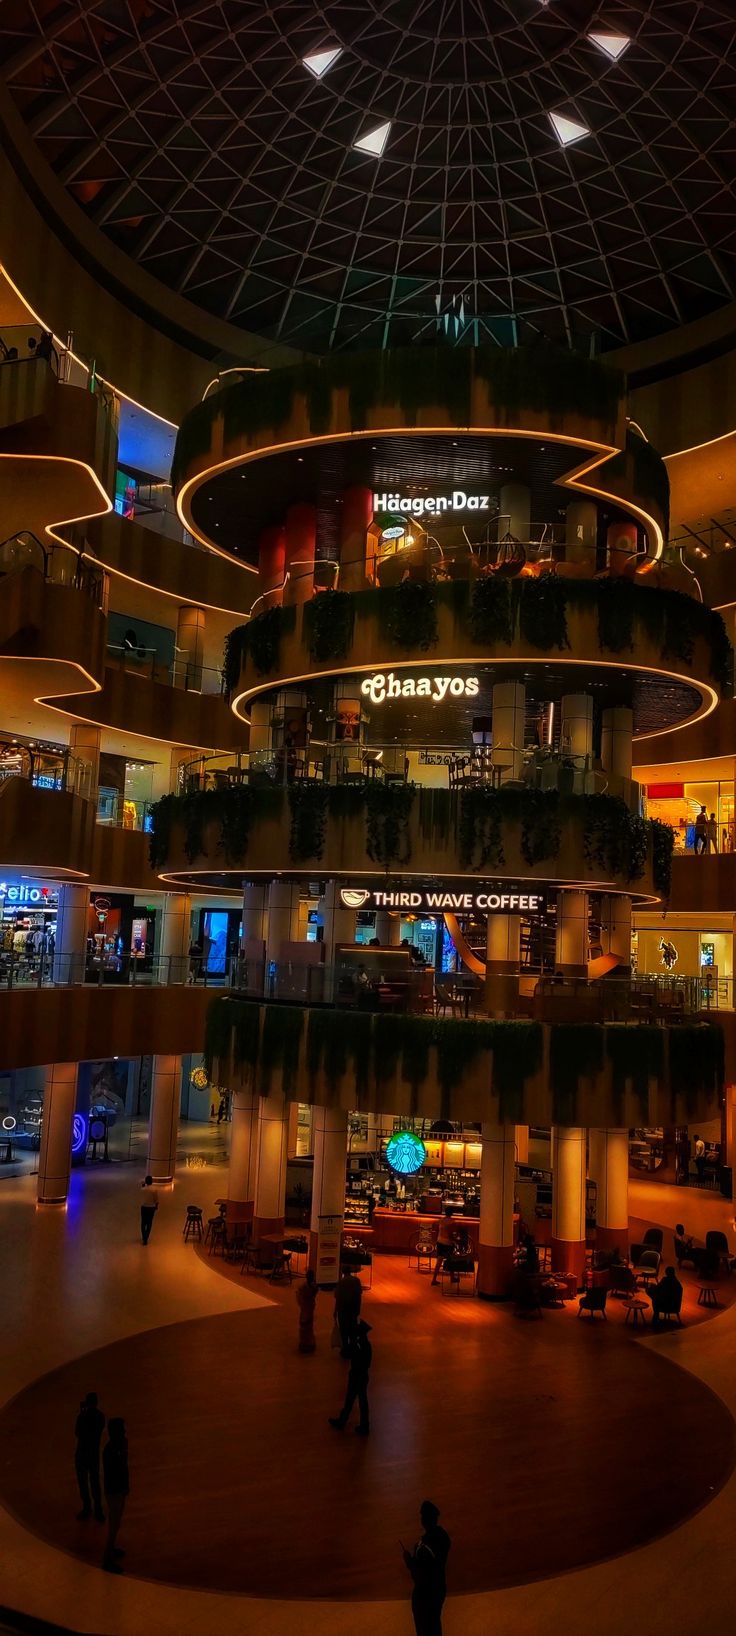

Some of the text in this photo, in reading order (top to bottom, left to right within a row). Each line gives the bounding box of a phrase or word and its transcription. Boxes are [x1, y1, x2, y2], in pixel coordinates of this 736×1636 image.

[361, 672, 480, 703] Chaayos
[373, 891, 422, 907] THIRD
[426, 893, 473, 908] WAVE
